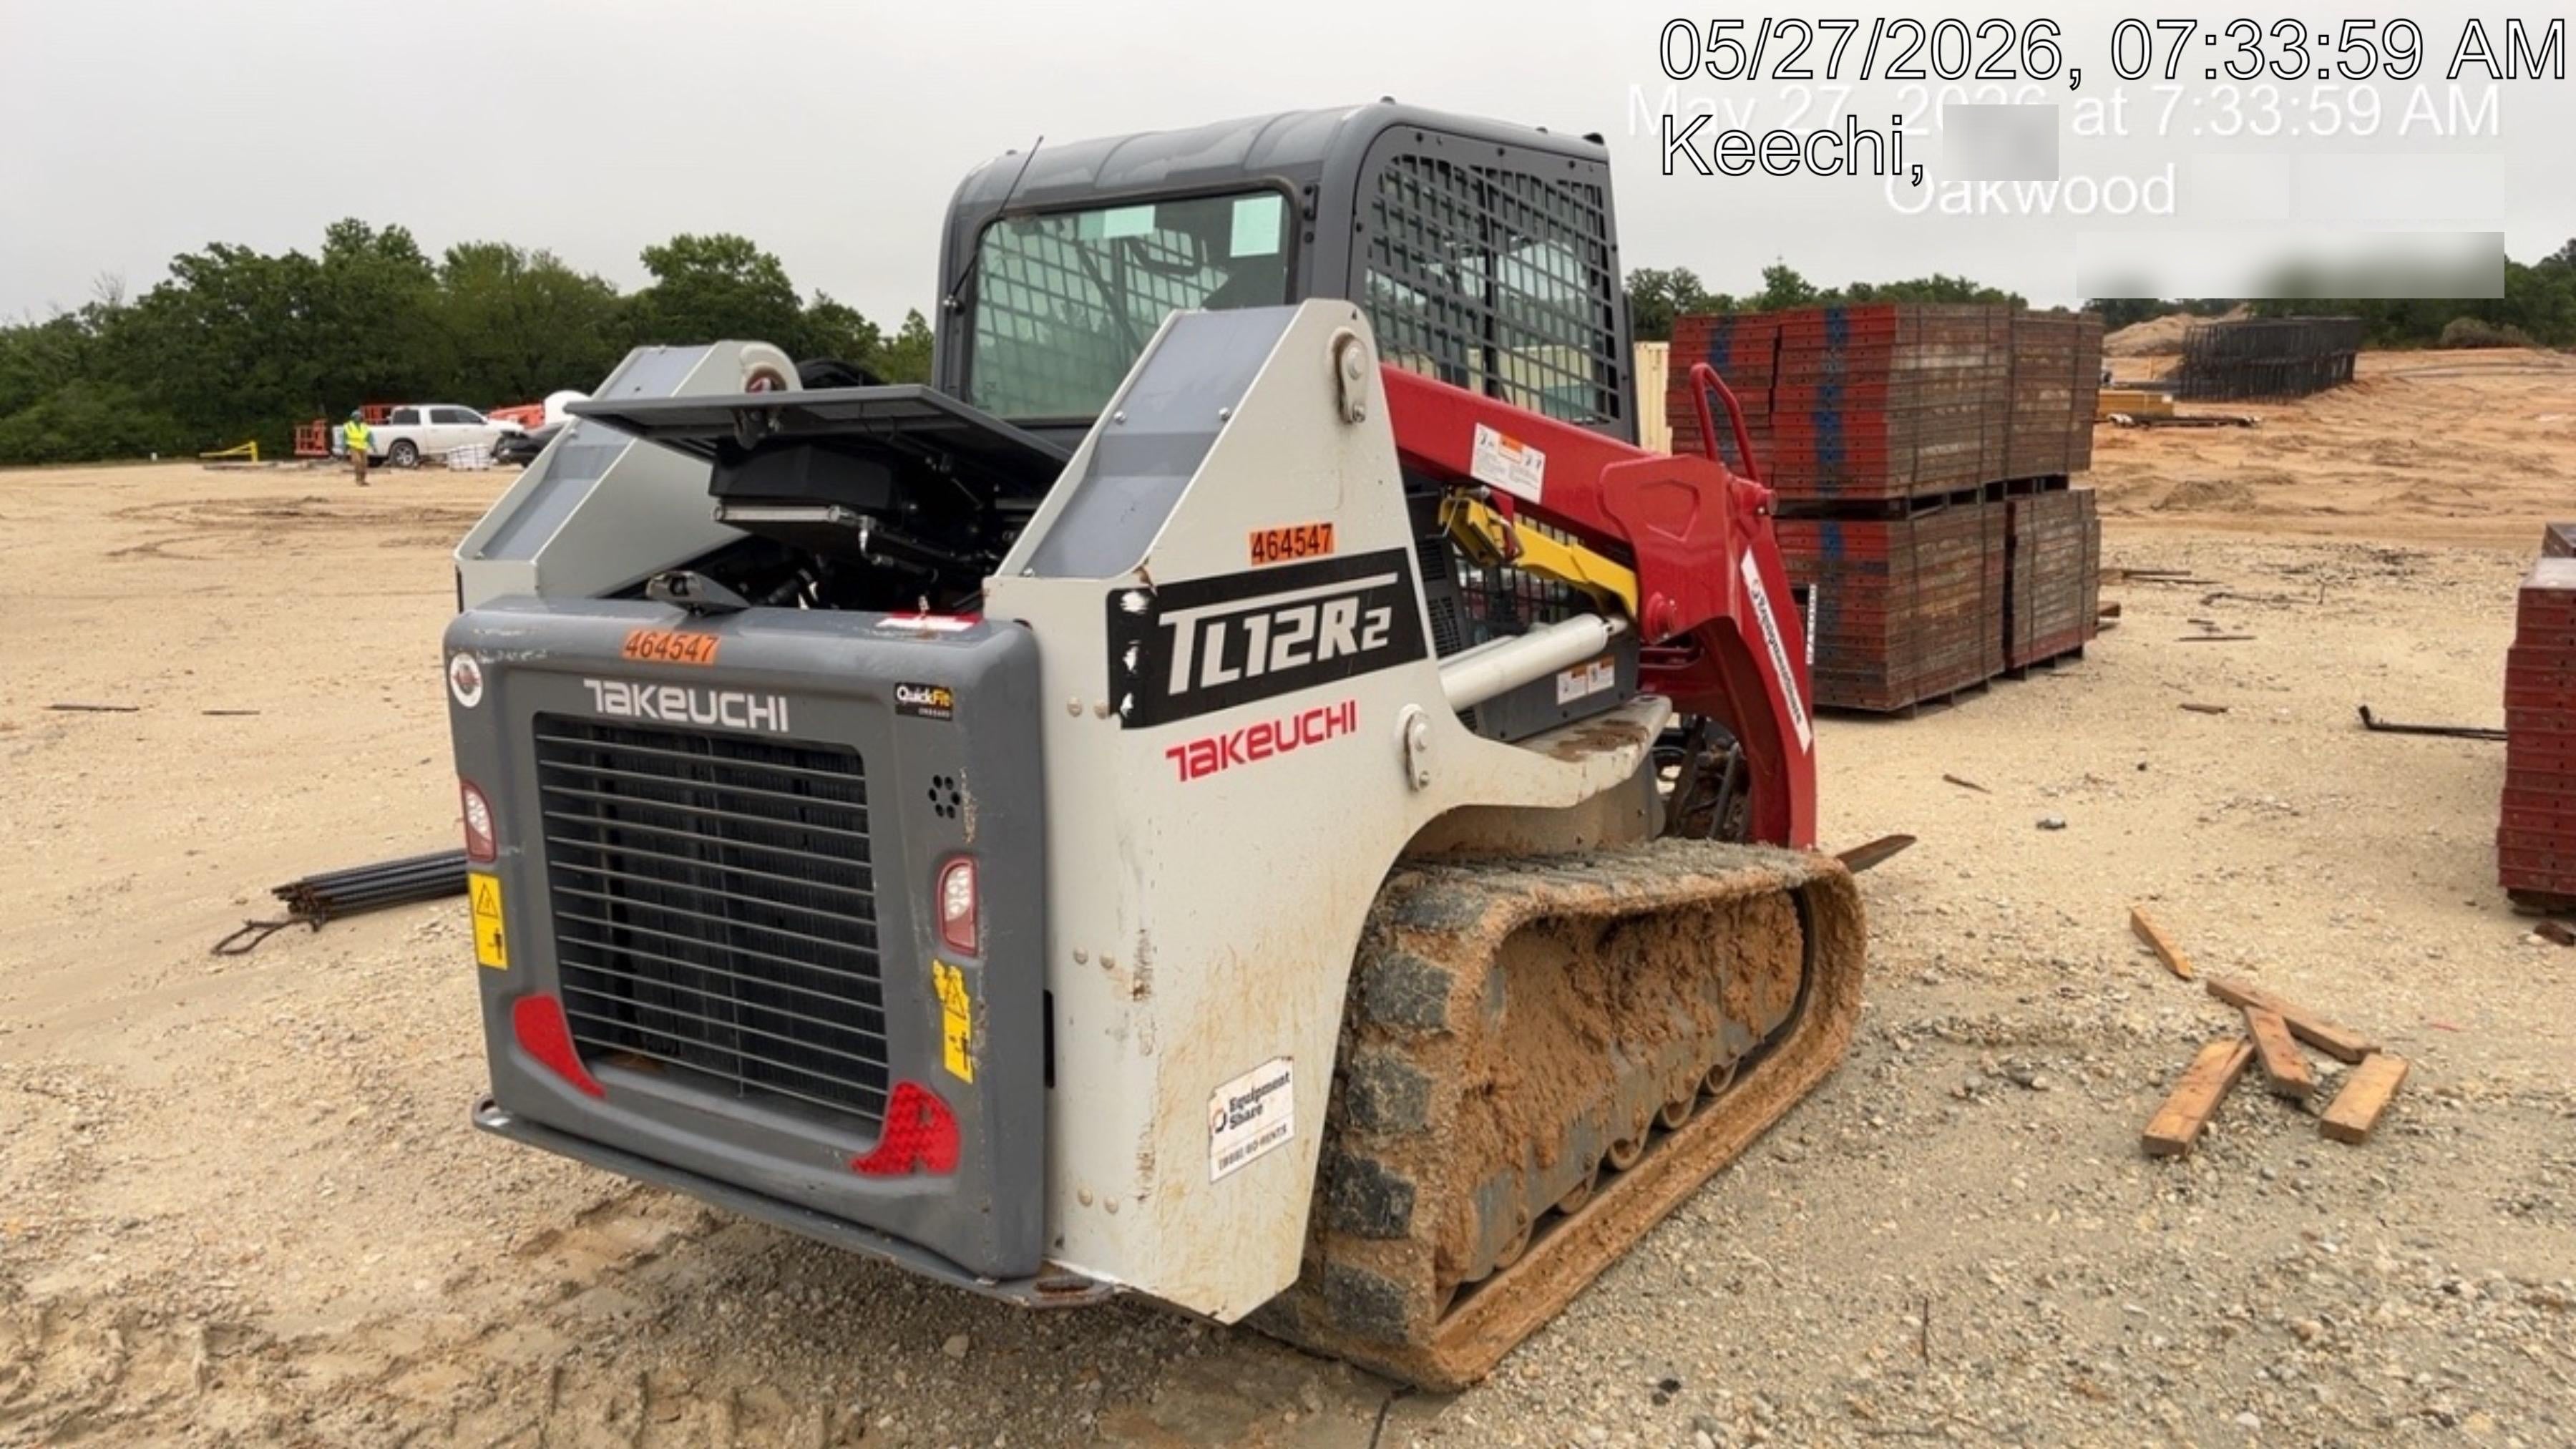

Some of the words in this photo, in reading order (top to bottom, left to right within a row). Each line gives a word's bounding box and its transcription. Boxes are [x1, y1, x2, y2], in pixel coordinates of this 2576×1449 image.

[1251, 522, 1334, 562] 464547
[625, 630, 719, 663] 464547
[1158, 572, 1399, 696] TL12R2
